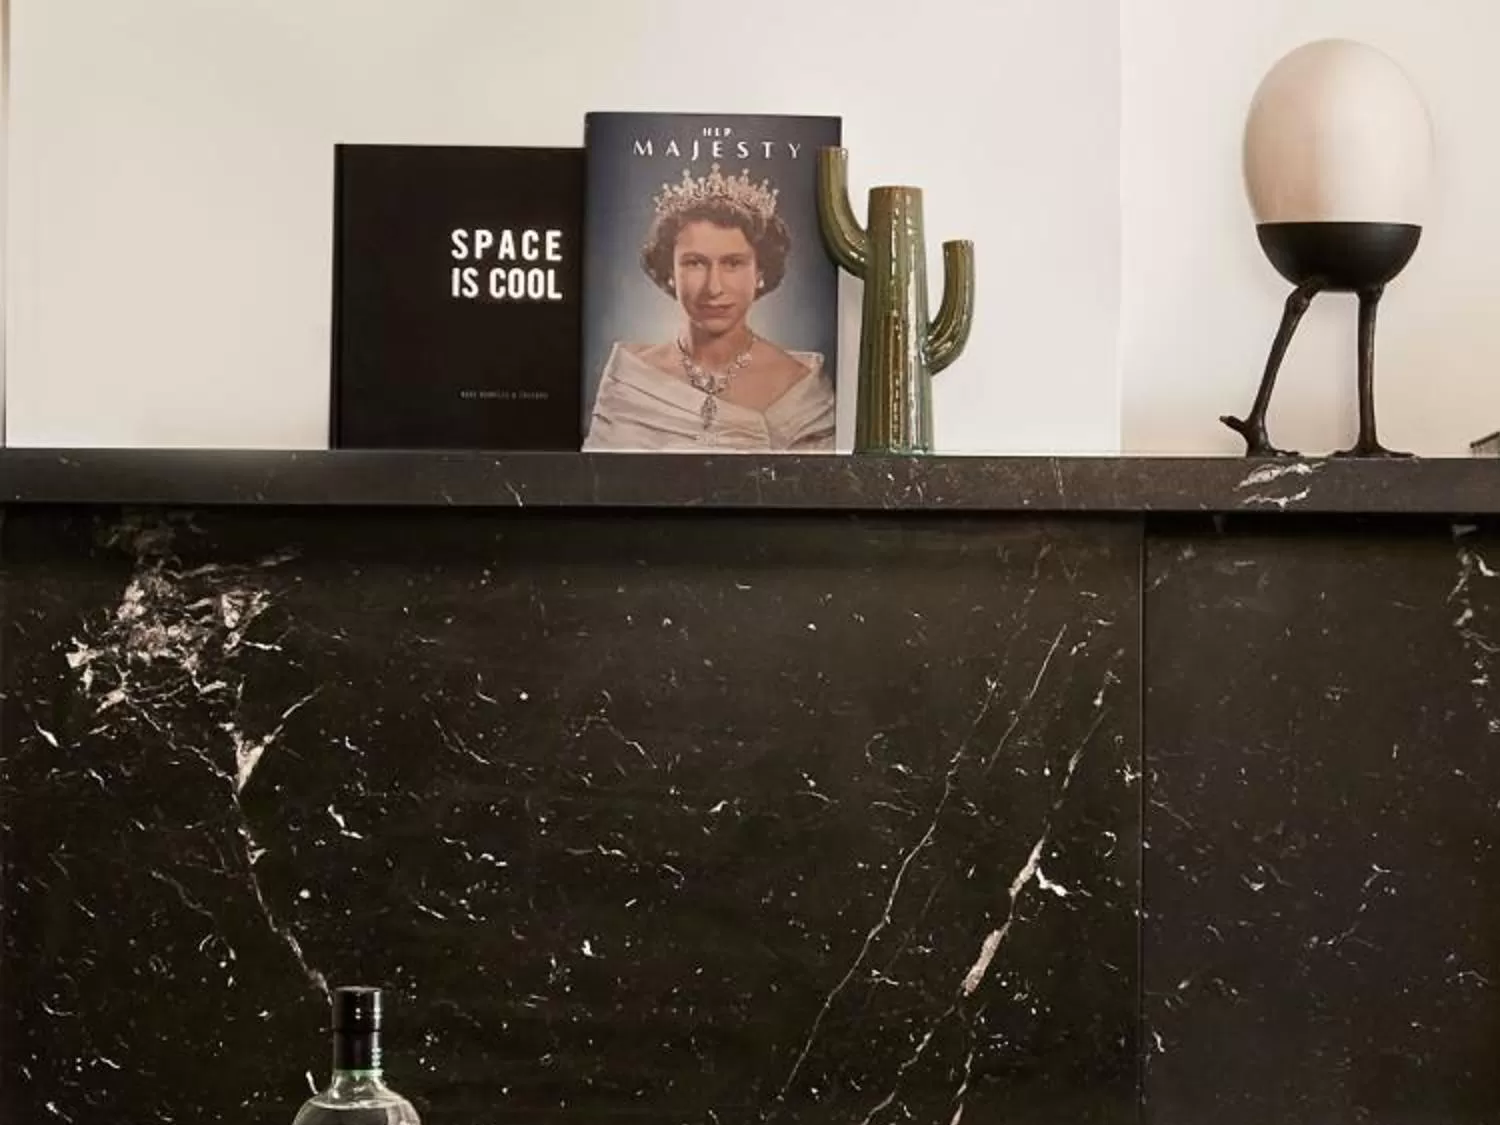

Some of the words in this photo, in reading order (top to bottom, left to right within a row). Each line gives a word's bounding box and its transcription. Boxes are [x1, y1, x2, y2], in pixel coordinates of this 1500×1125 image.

[632, 139, 801, 161] MAJESTY
[451, 228, 563, 261] SPACE
[451, 267, 479, 298] IS
[489, 267, 563, 299] COOL
